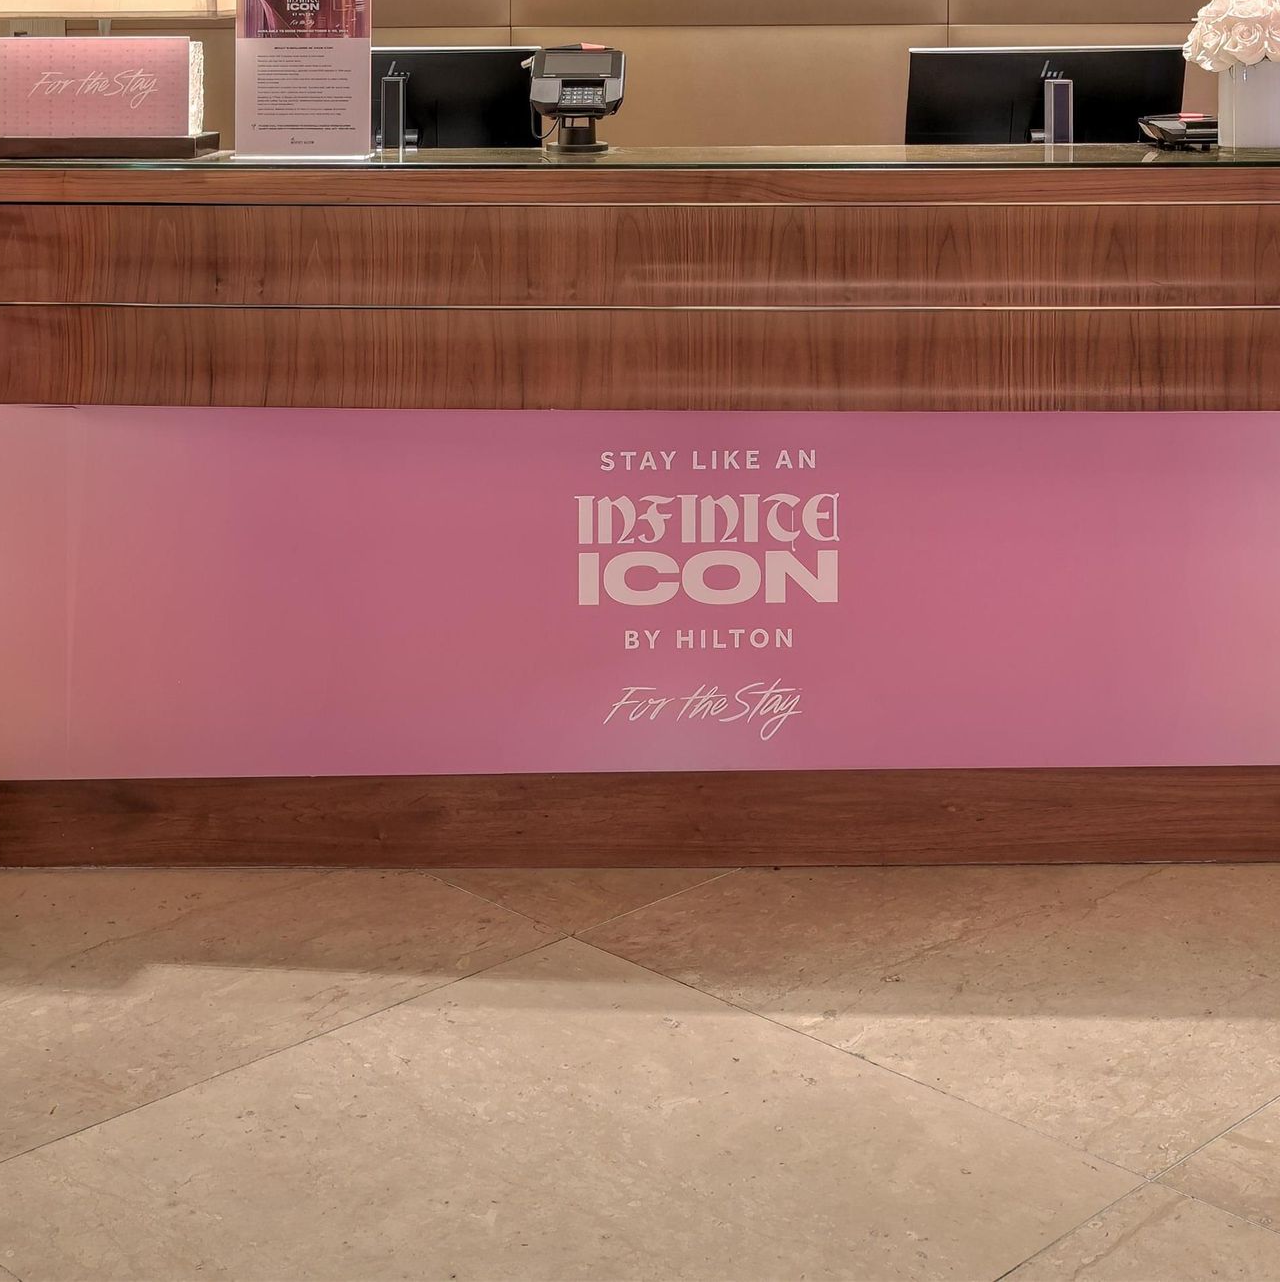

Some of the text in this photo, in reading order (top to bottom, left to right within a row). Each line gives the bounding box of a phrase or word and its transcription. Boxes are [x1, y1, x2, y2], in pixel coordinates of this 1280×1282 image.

[286, 3, 320, 11] ICON
[28, 69, 159, 109] For the Stay
[600, 449, 816, 470] STAY LIKE AN
[574, 492, 840, 552] INFINITE
[578, 549, 838, 606] ICON
[624, 628, 794, 649] BY HILTON
[603, 678, 803, 740] For the Stay
